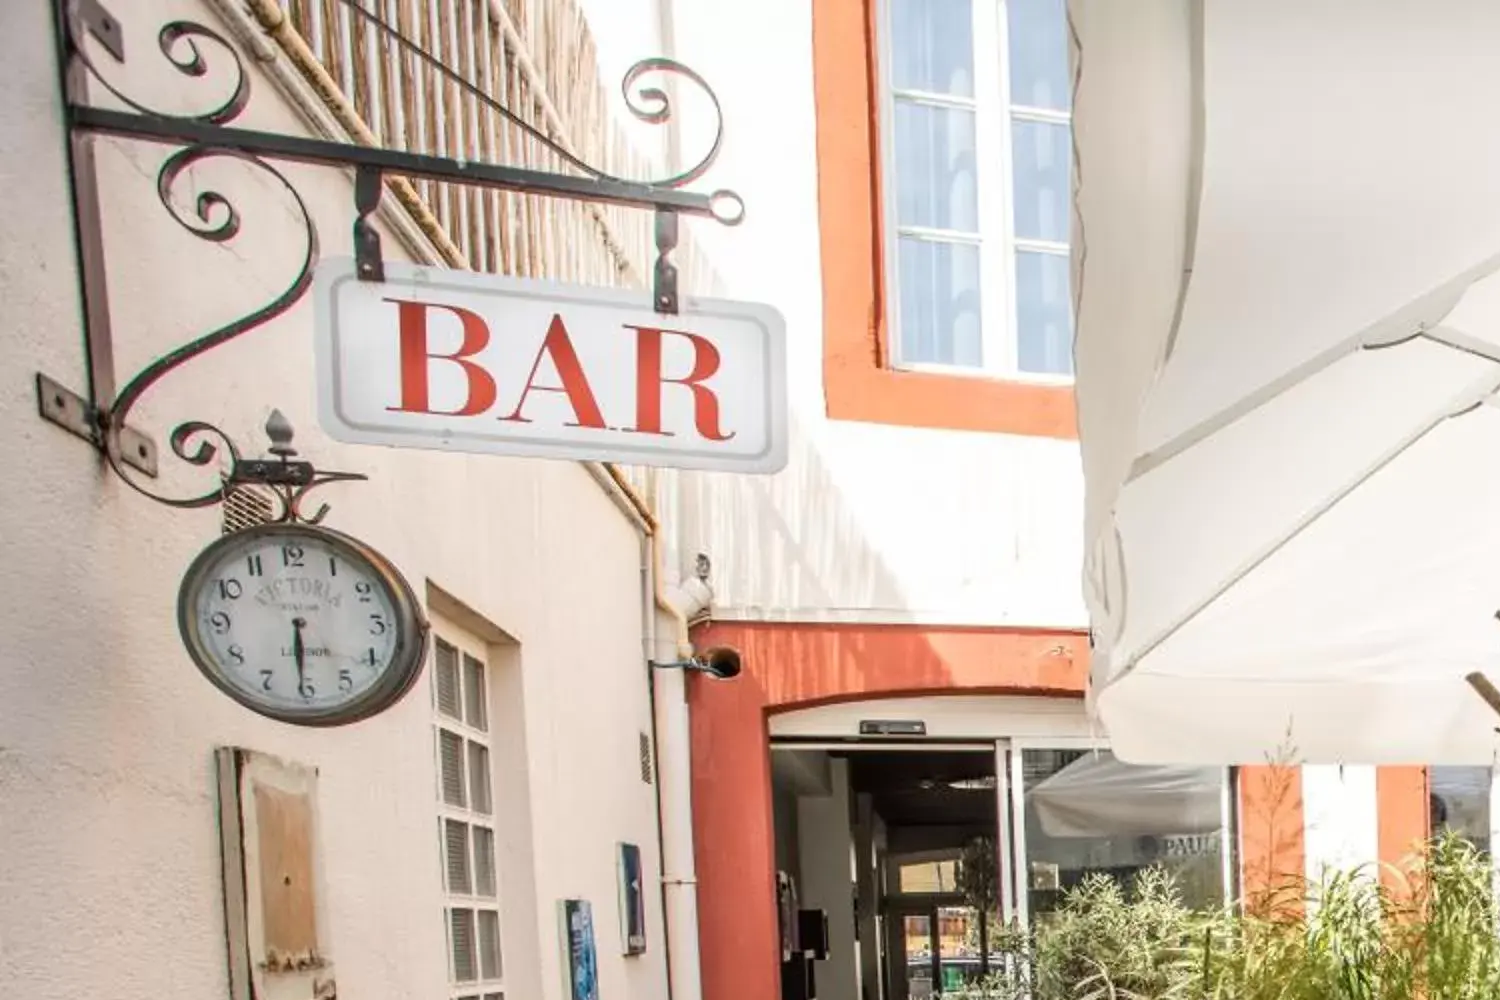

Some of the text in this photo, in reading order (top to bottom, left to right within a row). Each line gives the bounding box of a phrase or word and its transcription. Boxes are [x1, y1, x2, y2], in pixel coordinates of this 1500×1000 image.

[381, 296, 736, 441] BAR
[247, 555, 263, 577] 11
[282, 545, 304, 566] 12
[329, 557, 337, 577] 1
[219, 578, 243, 600] 10
[355, 582, 371, 602] 2
[211, 611, 231, 635] 9
[369, 613, 386, 636] 3
[227, 644, 244, 665] 8
[361, 647, 384, 667] 4
[260, 669, 274, 691] 7
[298, 677, 316, 699] 6
[338, 669, 353, 693] 5
